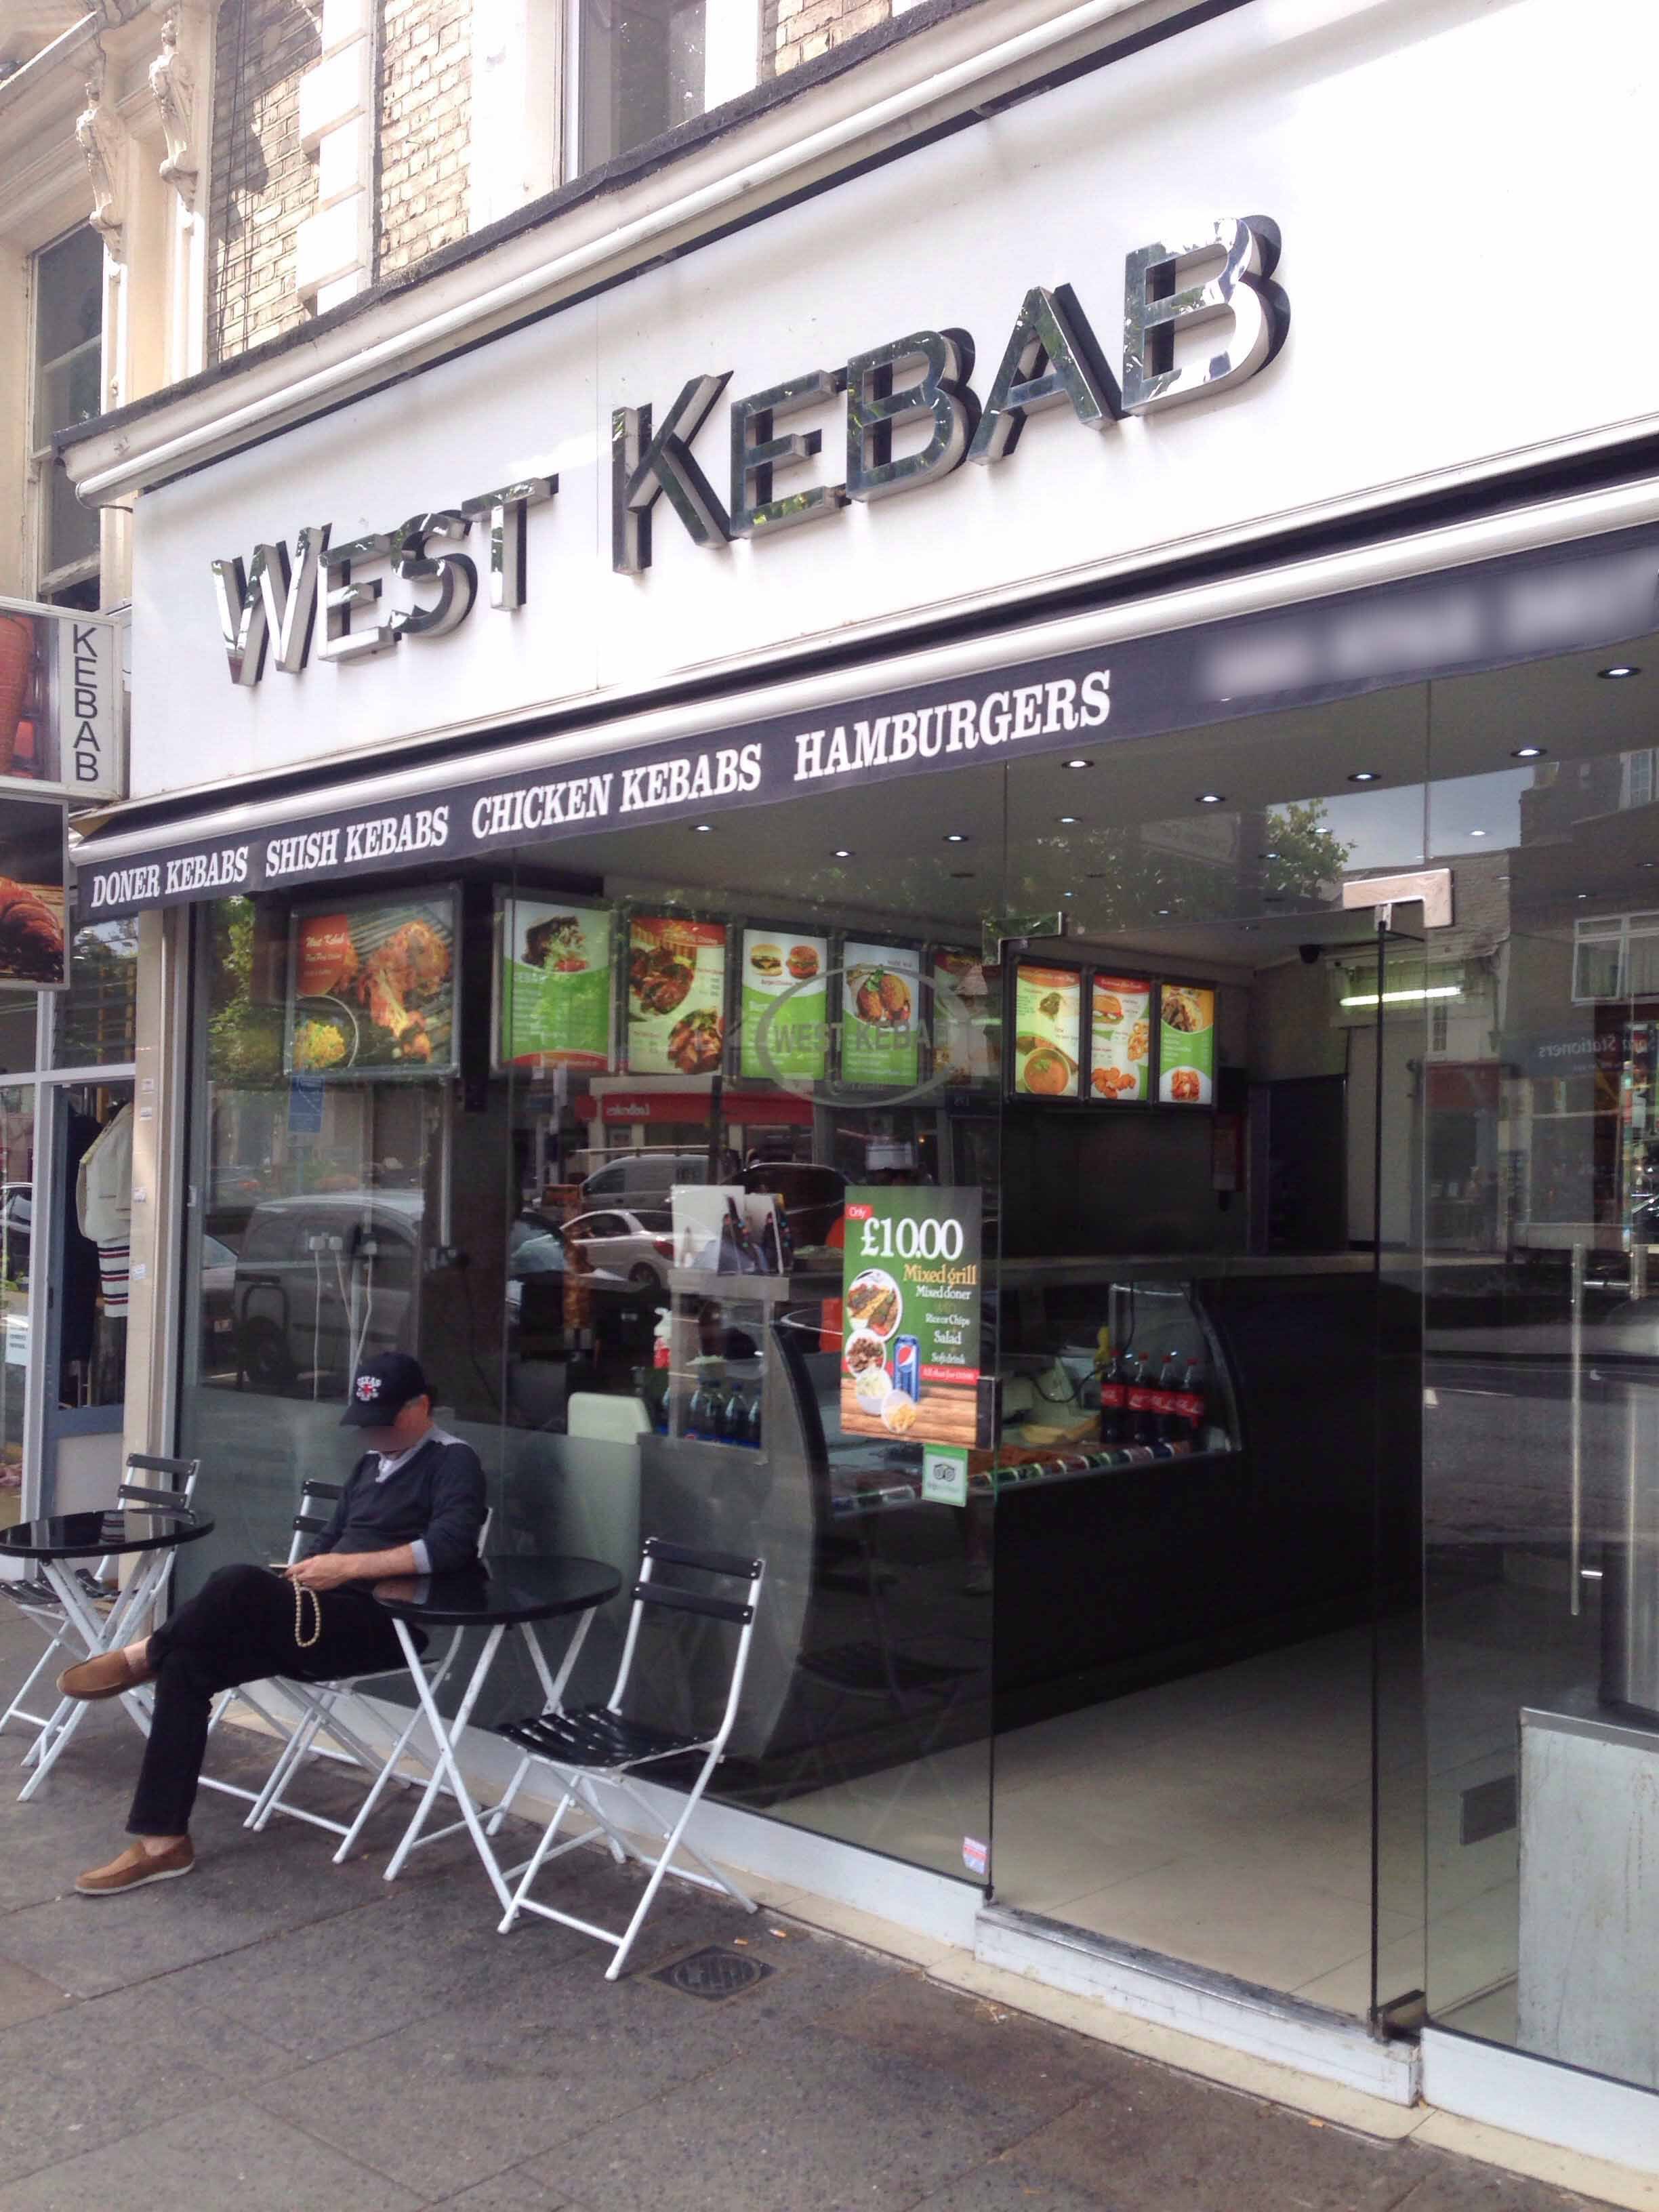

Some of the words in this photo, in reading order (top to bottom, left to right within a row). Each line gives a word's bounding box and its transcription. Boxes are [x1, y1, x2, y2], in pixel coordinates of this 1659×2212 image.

[211, 473, 559, 686] WEST
[611, 214, 1290, 575] KEBAB
[73, 623, 101, 782] KEBAB
[90, 863, 160, 908] DONER
[165, 846, 249, 895] KEBABS
[265, 828, 340, 878] SHISH
[344, 806, 451, 862] KEBABS
[472, 772, 611, 839] CHICKEN
[619, 743, 763, 813] KEBABS
[794, 669, 1112, 781] HAMBURGERS
[775, 1021, 842, 1052] WEST
[849, 1206, 867, 1219] Only
[860, 1217, 964, 1261] £10.00
[903, 1263, 946, 1284] Mixed
[947, 1265, 977, 1288] grill
[916, 1285, 943, 1298] Mixed
[944, 1285, 972, 1300] doner
[949, 1314, 971, 1328] Chips
[934, 1330, 962, 1345] Salad
